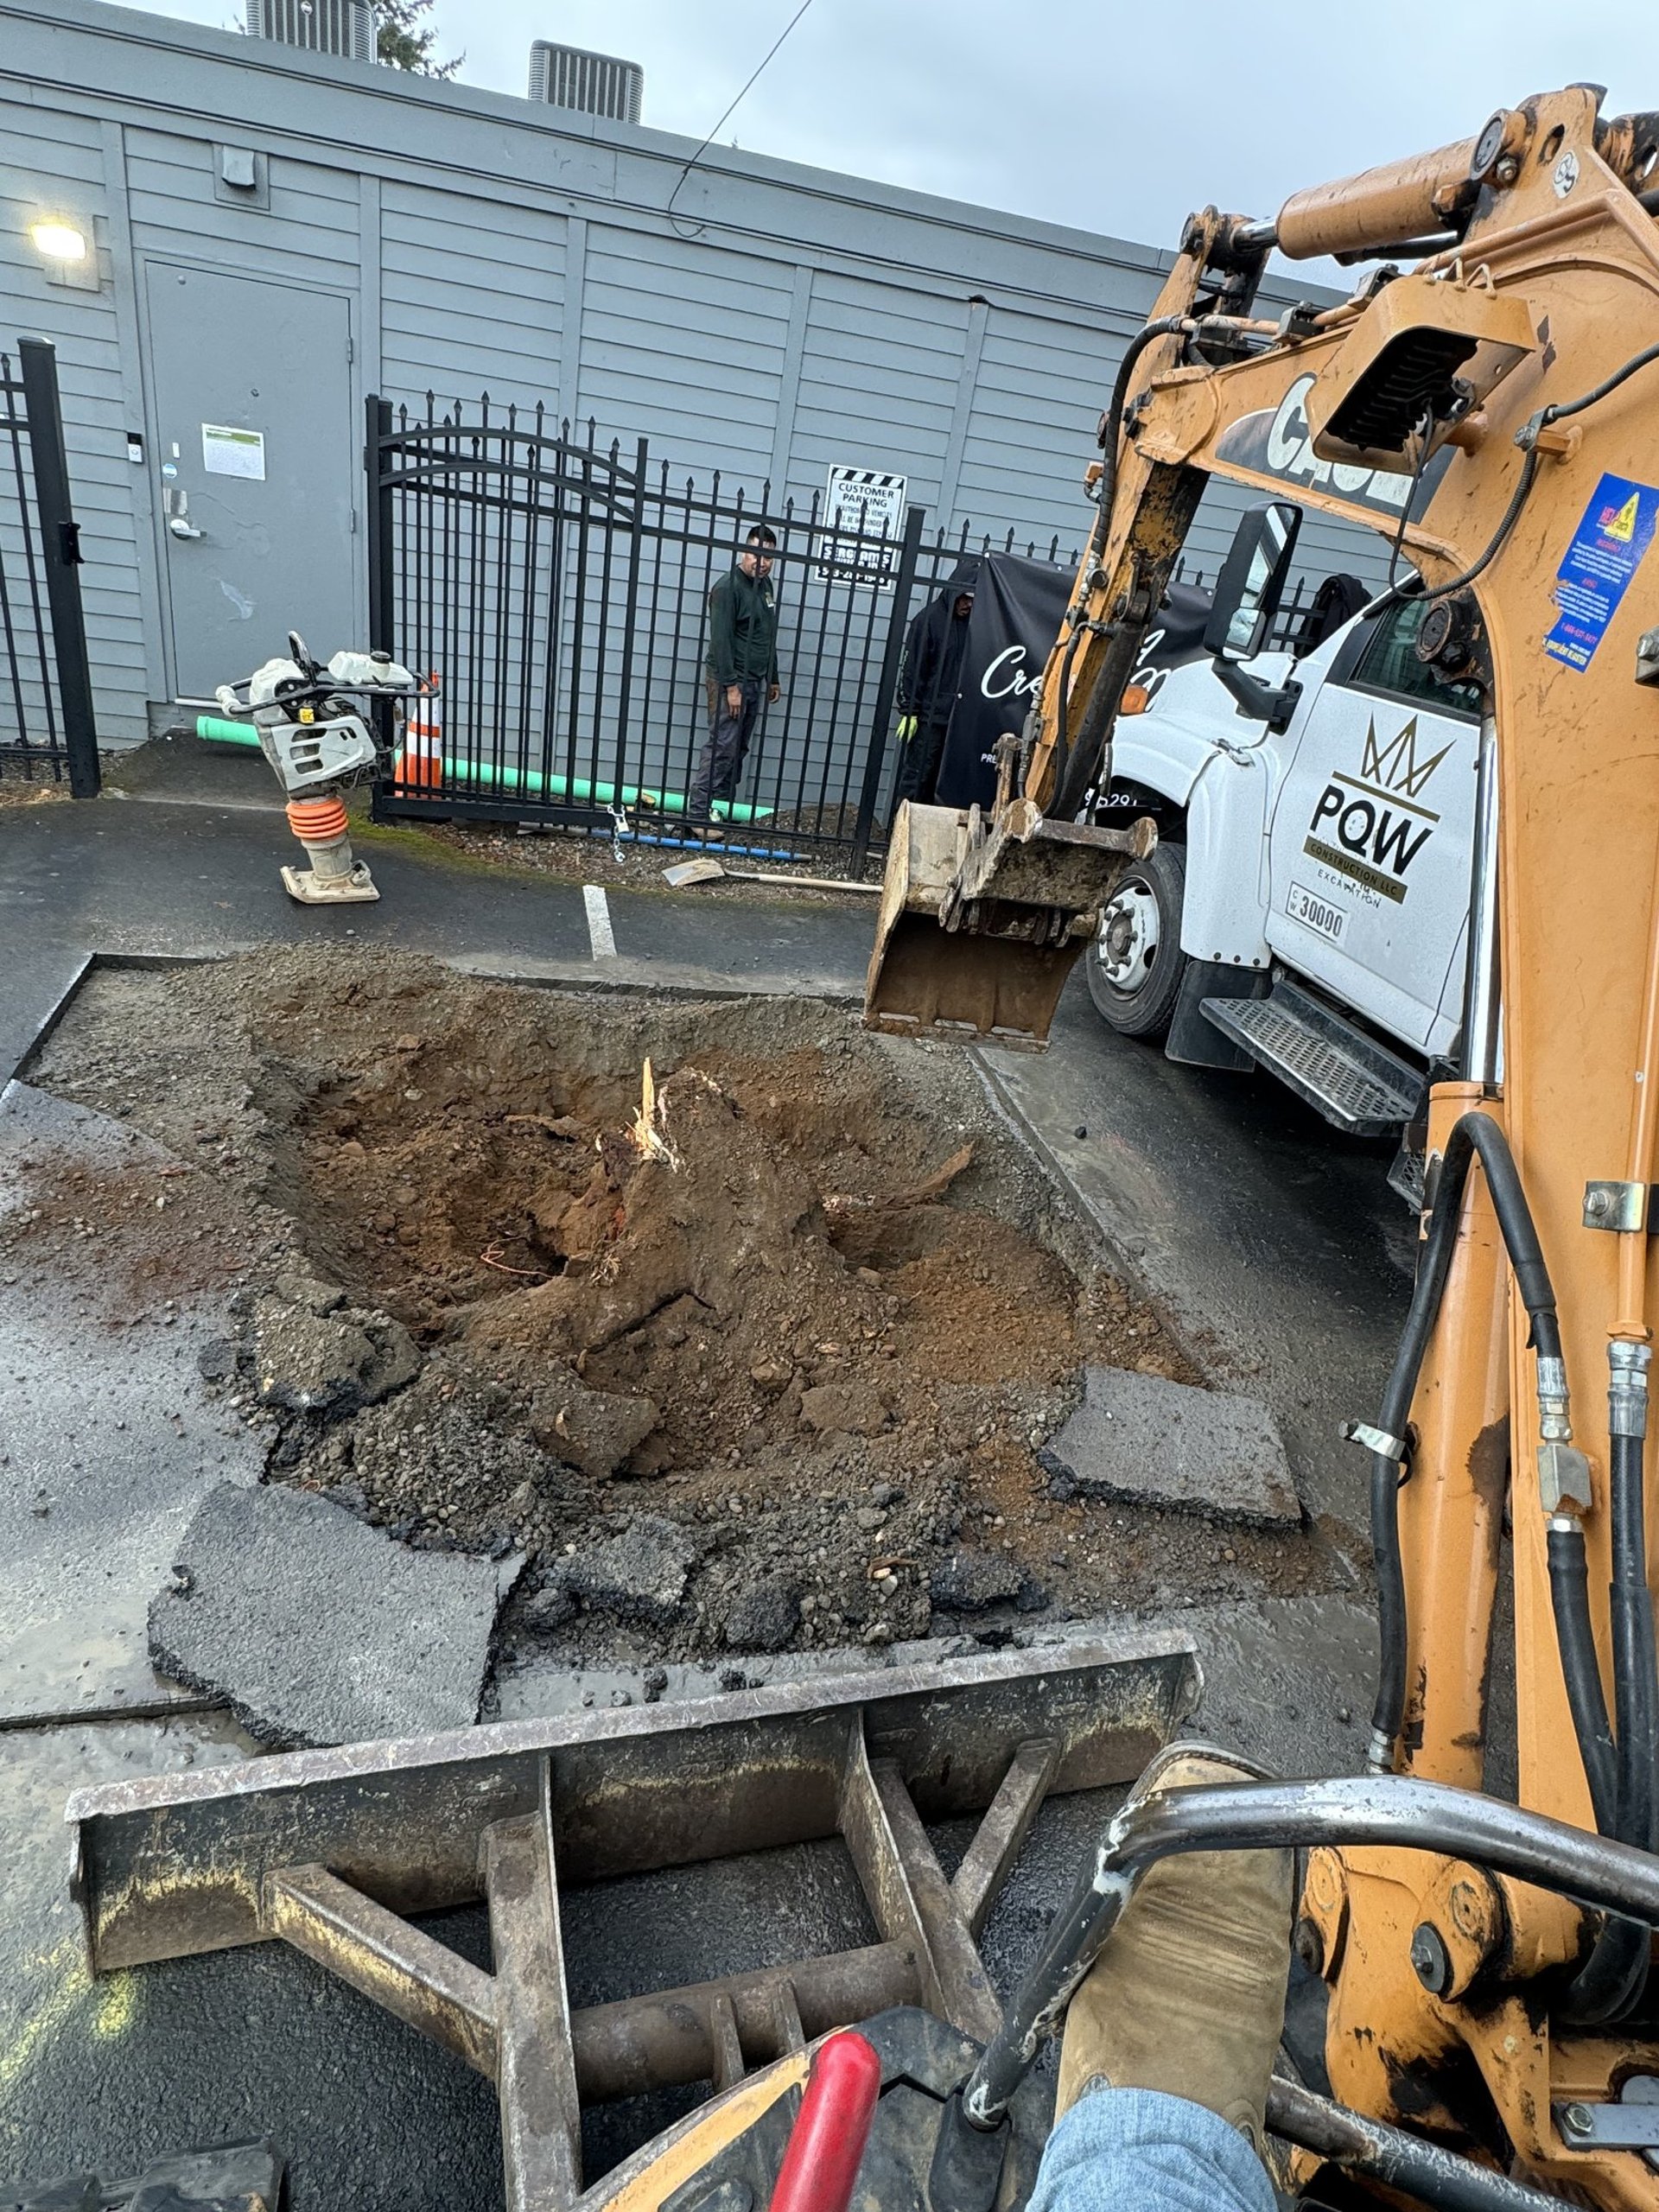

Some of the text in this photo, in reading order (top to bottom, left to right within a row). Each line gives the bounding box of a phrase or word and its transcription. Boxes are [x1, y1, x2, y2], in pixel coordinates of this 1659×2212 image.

[838, 482, 894, 499] CUSTOMER
[1309, 784, 1434, 876] PQW
[1310, 843, 1378, 885] CONSTRUCTION
[1380, 880, 1398, 895] LLC
[1317, 868, 1382, 908] EXCAVATION
[1300, 895, 1343, 938] 30000
